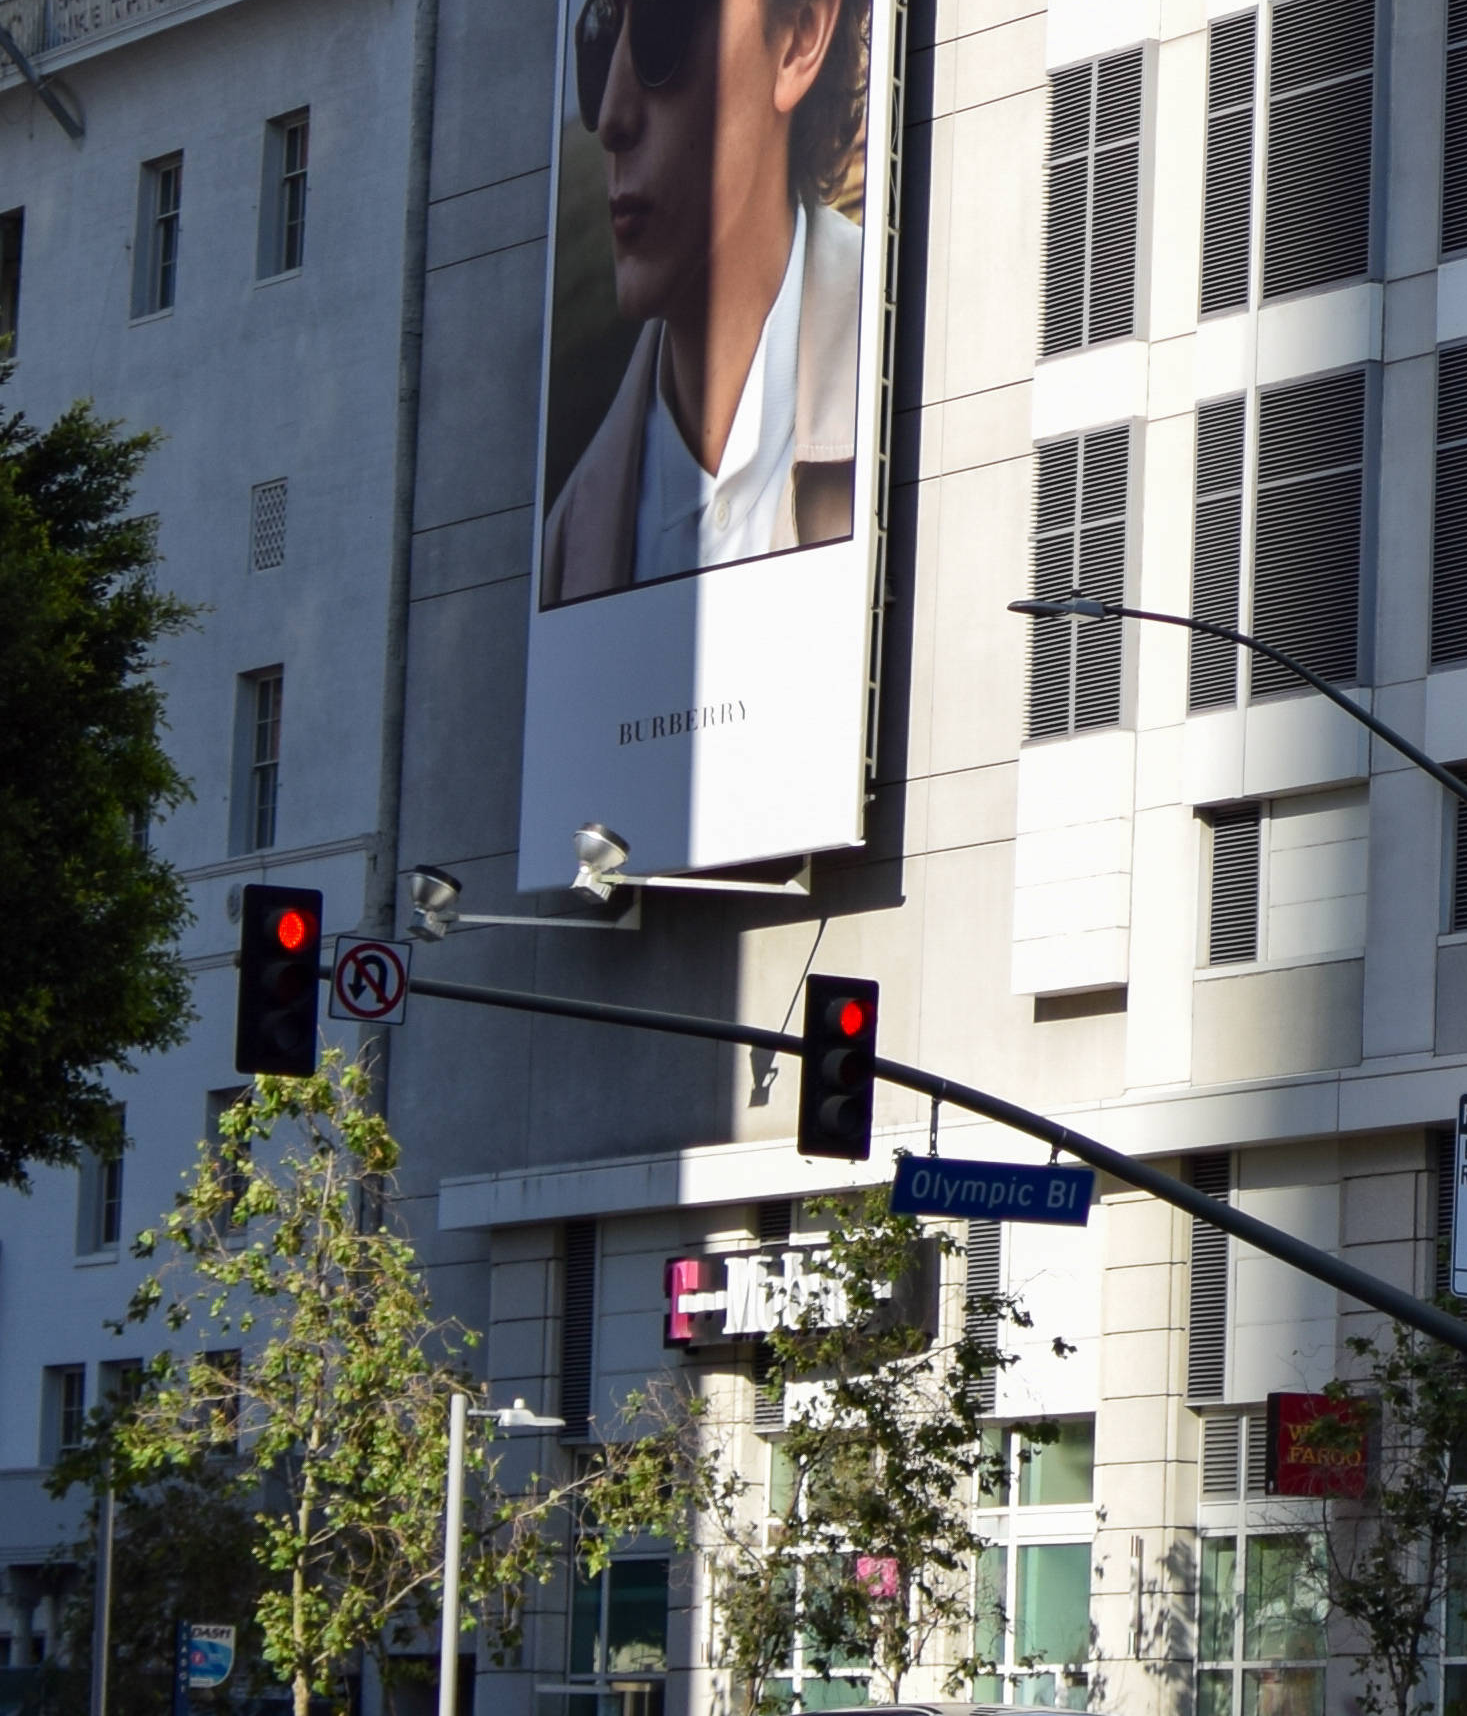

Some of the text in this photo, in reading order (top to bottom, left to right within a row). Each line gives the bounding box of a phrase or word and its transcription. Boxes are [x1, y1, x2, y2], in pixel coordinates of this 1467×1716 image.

[617, 699, 749, 746] BURBERRY
[911, 1169, 1076, 1209] Olympic Bl
[669, 1246, 876, 1340] T-Mobil
[191, 1627, 232, 1639] DASH
